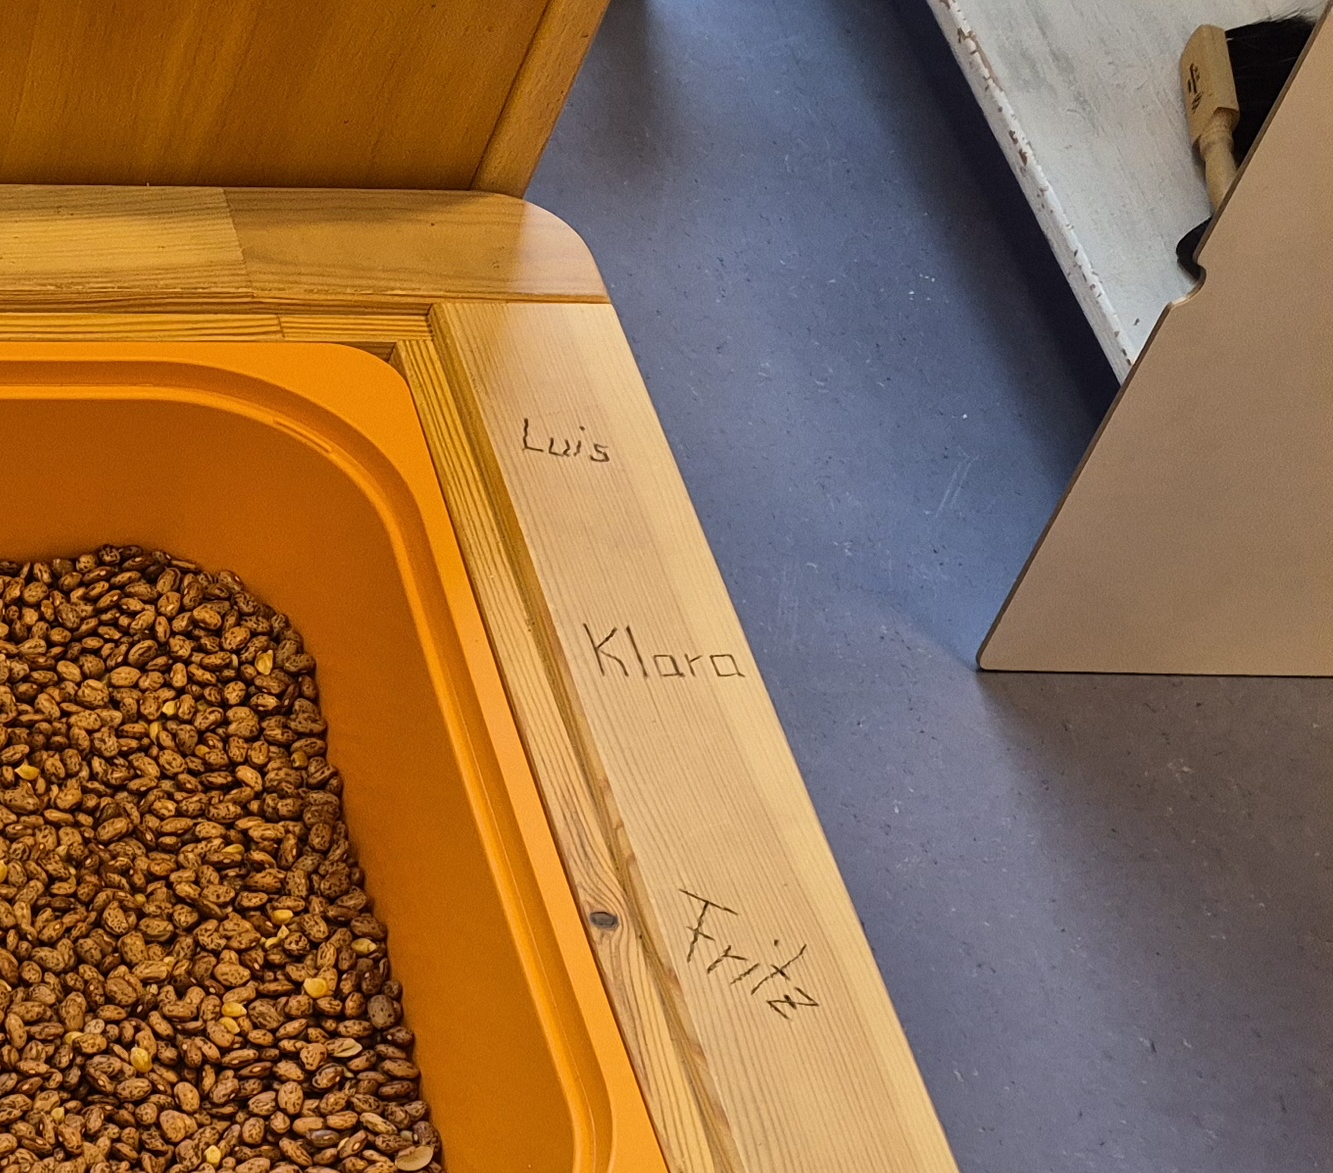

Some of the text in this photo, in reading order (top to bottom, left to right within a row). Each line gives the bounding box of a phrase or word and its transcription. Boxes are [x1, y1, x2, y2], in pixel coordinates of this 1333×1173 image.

[521, 417, 611, 463] Luis
[582, 622, 746, 678] Klara
[678, 888, 820, 1021] Fritz
